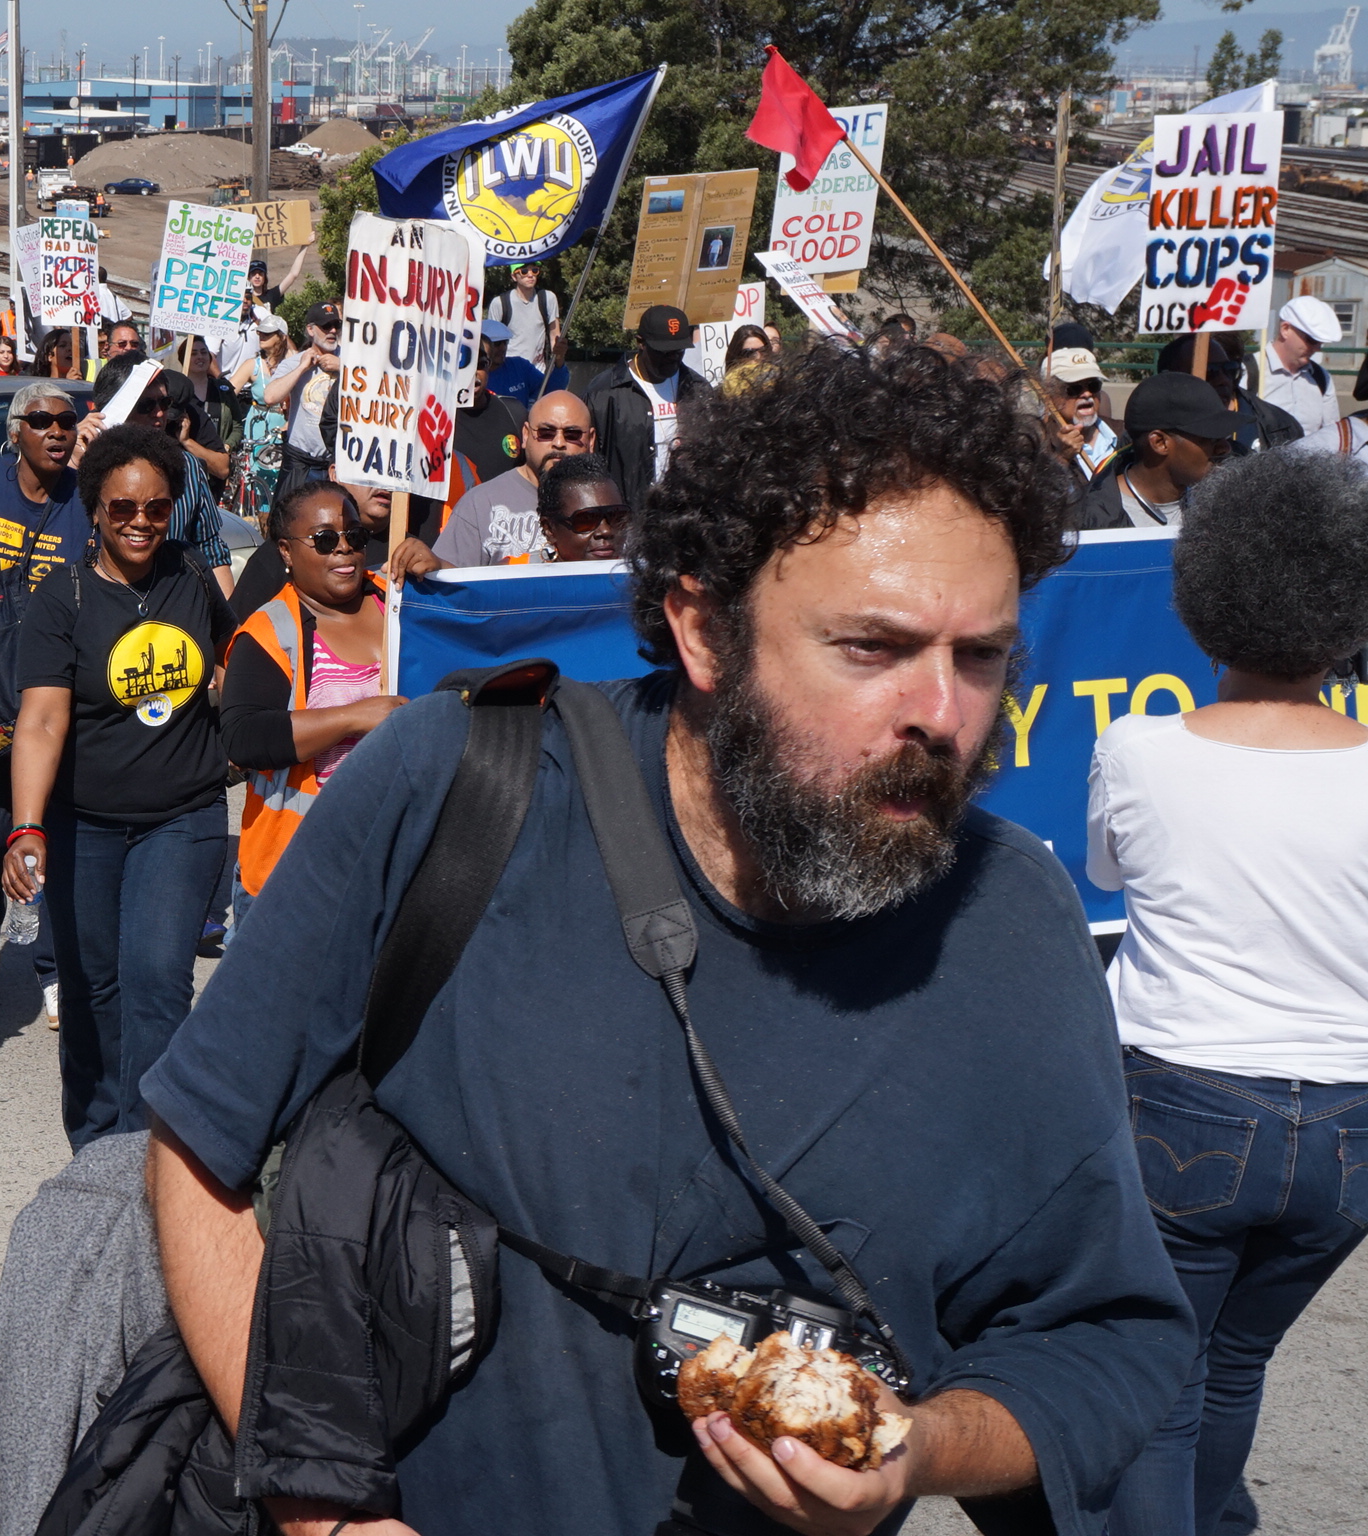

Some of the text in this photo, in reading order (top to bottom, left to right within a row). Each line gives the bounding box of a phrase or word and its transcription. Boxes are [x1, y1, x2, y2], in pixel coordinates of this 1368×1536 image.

[1155, 123, 1267, 177] JAIL
[464, 137, 574, 201] ILWU
[779, 175, 879, 197] MRDERED
[782, 211, 863, 238] COLD
[1149, 185, 1278, 231] KILLER
[40, 219, 98, 243] REPEAL
[45, 240, 97, 255] BAD LAW
[390, 224, 424, 250] AN
[484, 232, 560, 258] LOCAL 13
[187, 240, 217, 263] 4
[231, 260, 248, 268] COPS
[1145, 233, 1272, 289] COPS
[84, 275, 96, 287] OF
[347, 249, 463, 320] INJURY
[43, 295, 82, 306] RIGHTS
[157, 284, 244, 323] PEREZ
[345, 317, 458, 382] TO ONE
[341, 364, 411, 402] IS AN
[340, 395, 415, 431] INJURY
[339, 423, 416, 483] TO ALL
[1073, 673, 1196, 738] TO
